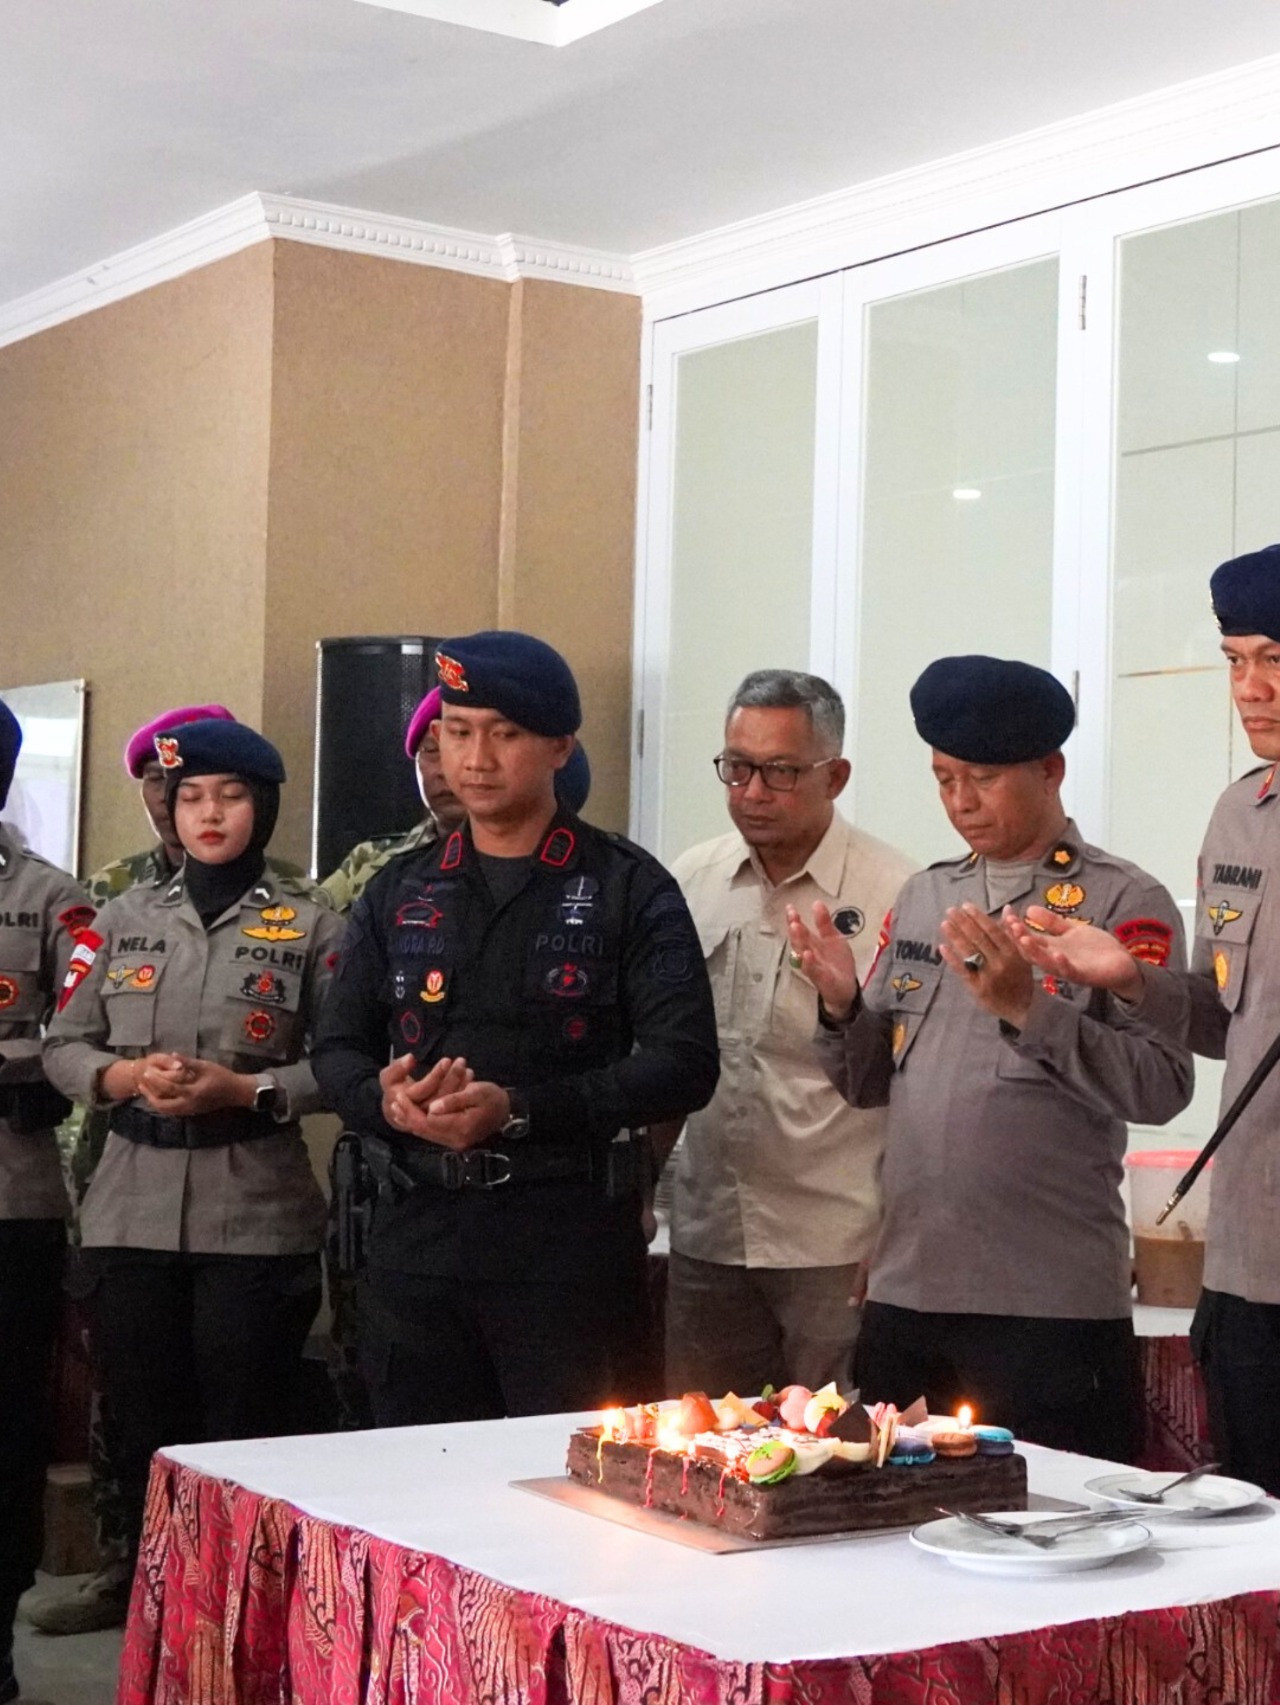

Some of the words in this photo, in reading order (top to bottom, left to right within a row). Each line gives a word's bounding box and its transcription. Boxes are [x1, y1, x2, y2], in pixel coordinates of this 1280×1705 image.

[117, 936, 166, 954] NELA
[535, 933, 604, 955] POLRI
[235, 946, 304, 970] POLRI
